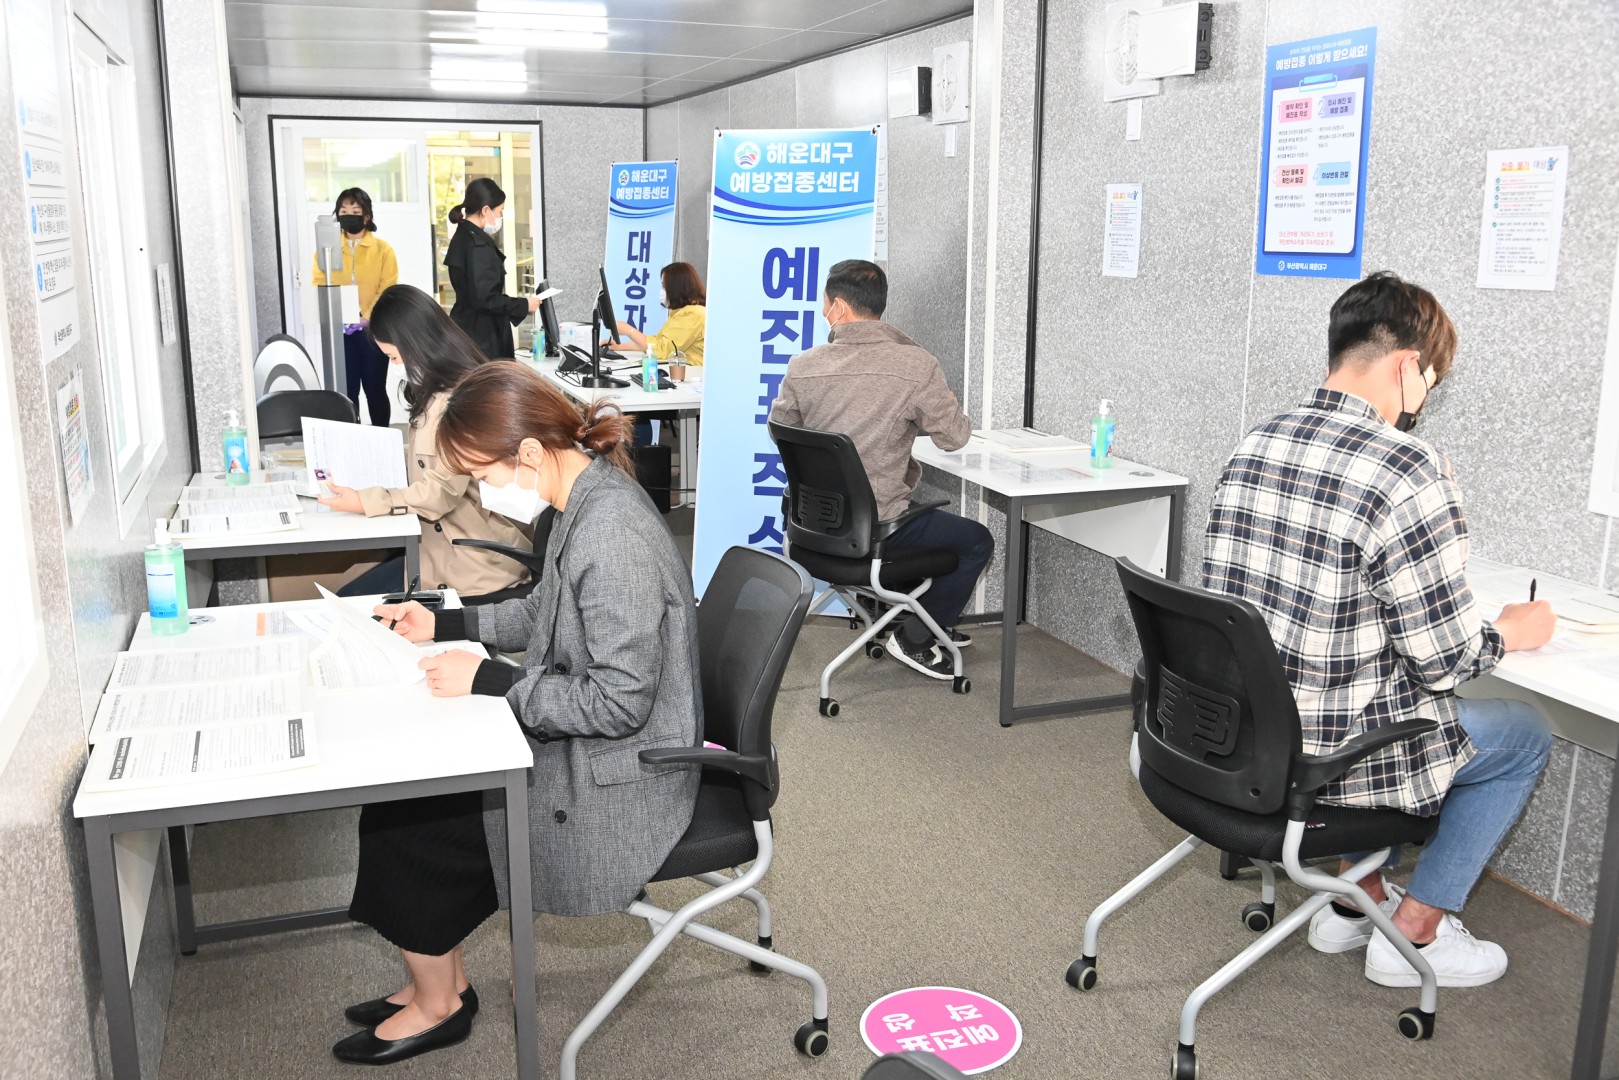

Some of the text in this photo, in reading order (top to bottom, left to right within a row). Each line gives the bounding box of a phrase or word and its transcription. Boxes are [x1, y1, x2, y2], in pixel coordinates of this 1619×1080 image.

[1275, 56, 1306, 71] 예방접종
[1308, 51, 1332, 66] 이렇게
[1332, 44, 1368, 63] 받으세요!
[766, 141, 853, 165] 해운대구
[631, 168, 669, 187] 해운대구
[729, 170, 859, 194] 예방접종센터
[1321, 171, 1339, 179] 이상반응
[615, 185, 670, 201] 예방접종센터
[1286, 262, 1328, 271] 부산광역시 해운대구
